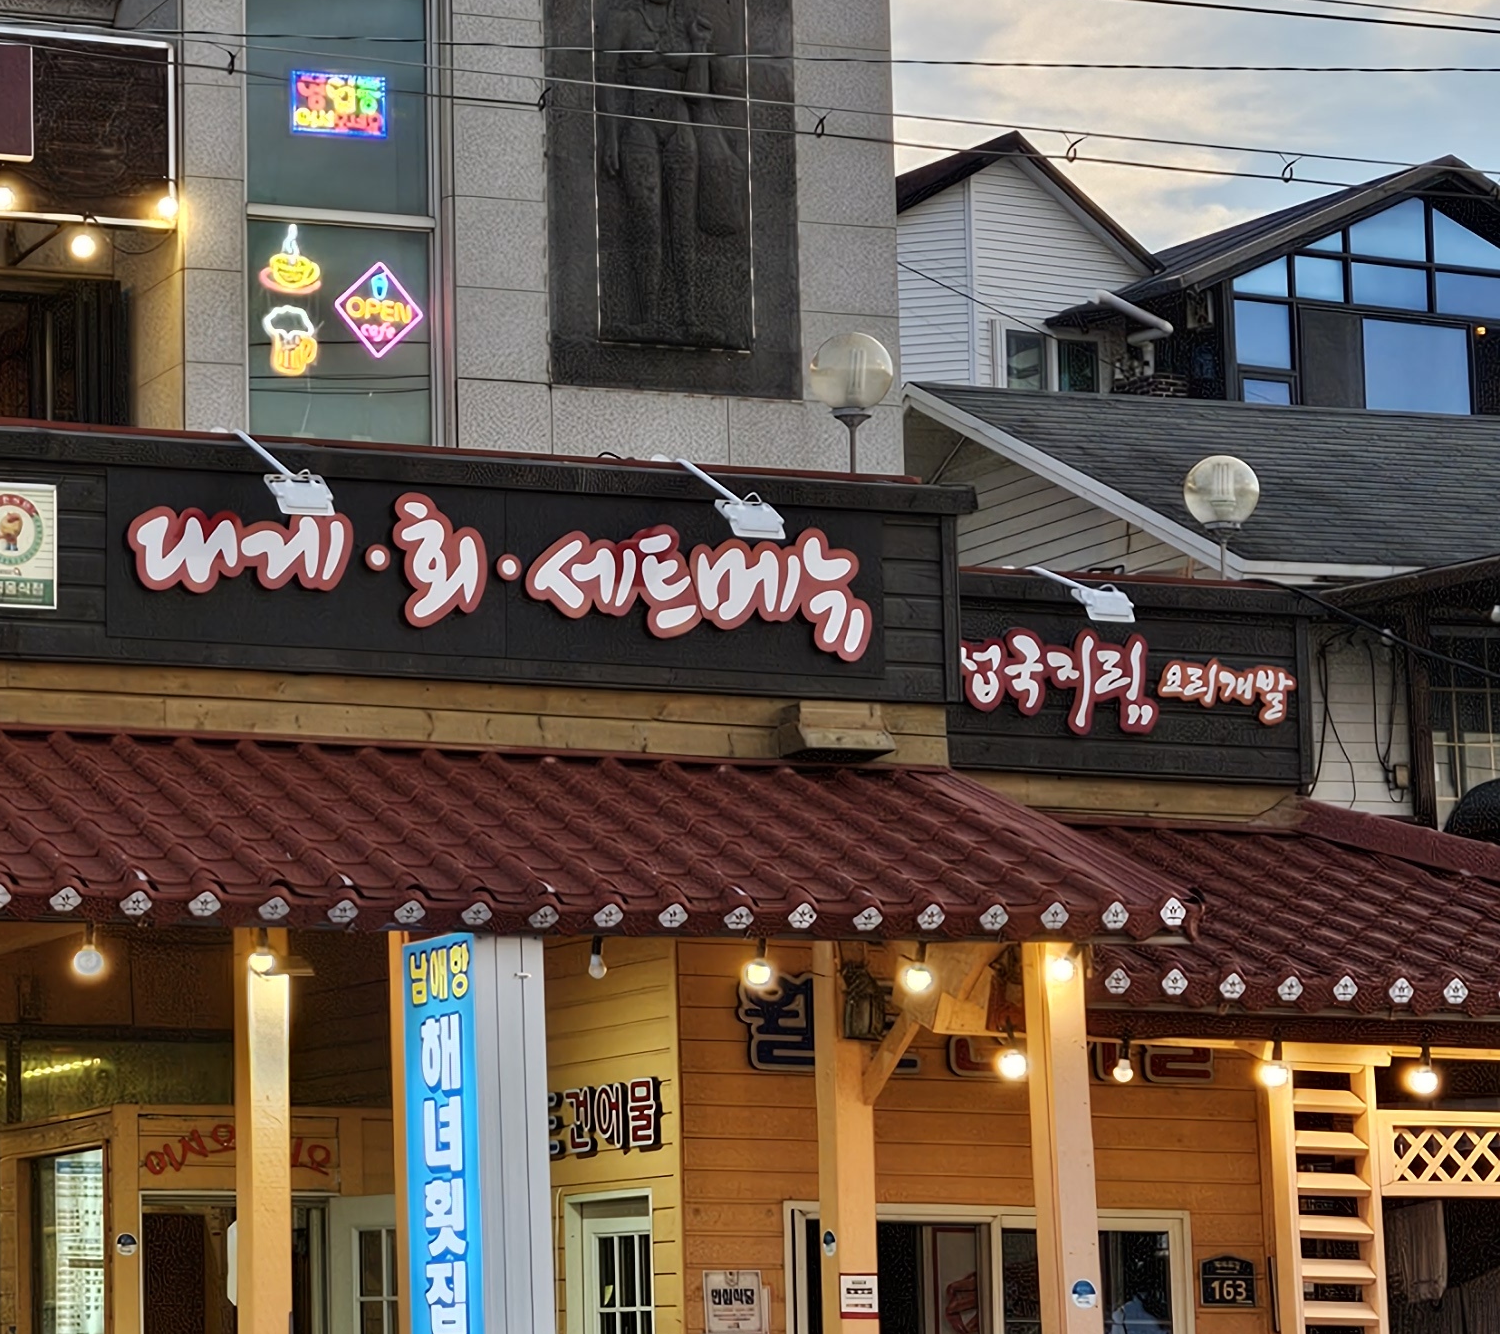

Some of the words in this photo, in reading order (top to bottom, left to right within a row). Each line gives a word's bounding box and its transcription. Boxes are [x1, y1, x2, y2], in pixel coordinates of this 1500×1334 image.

[346, 296, 413, 324] OPEN
[361, 322, 396, 342] cafe
[1162, 659, 1295, 724] 요리개발
[410, 942, 469, 1005] 남애항
[564, 1077, 656, 1152] 건어물
[1211, 1280, 1246, 1300] 163
